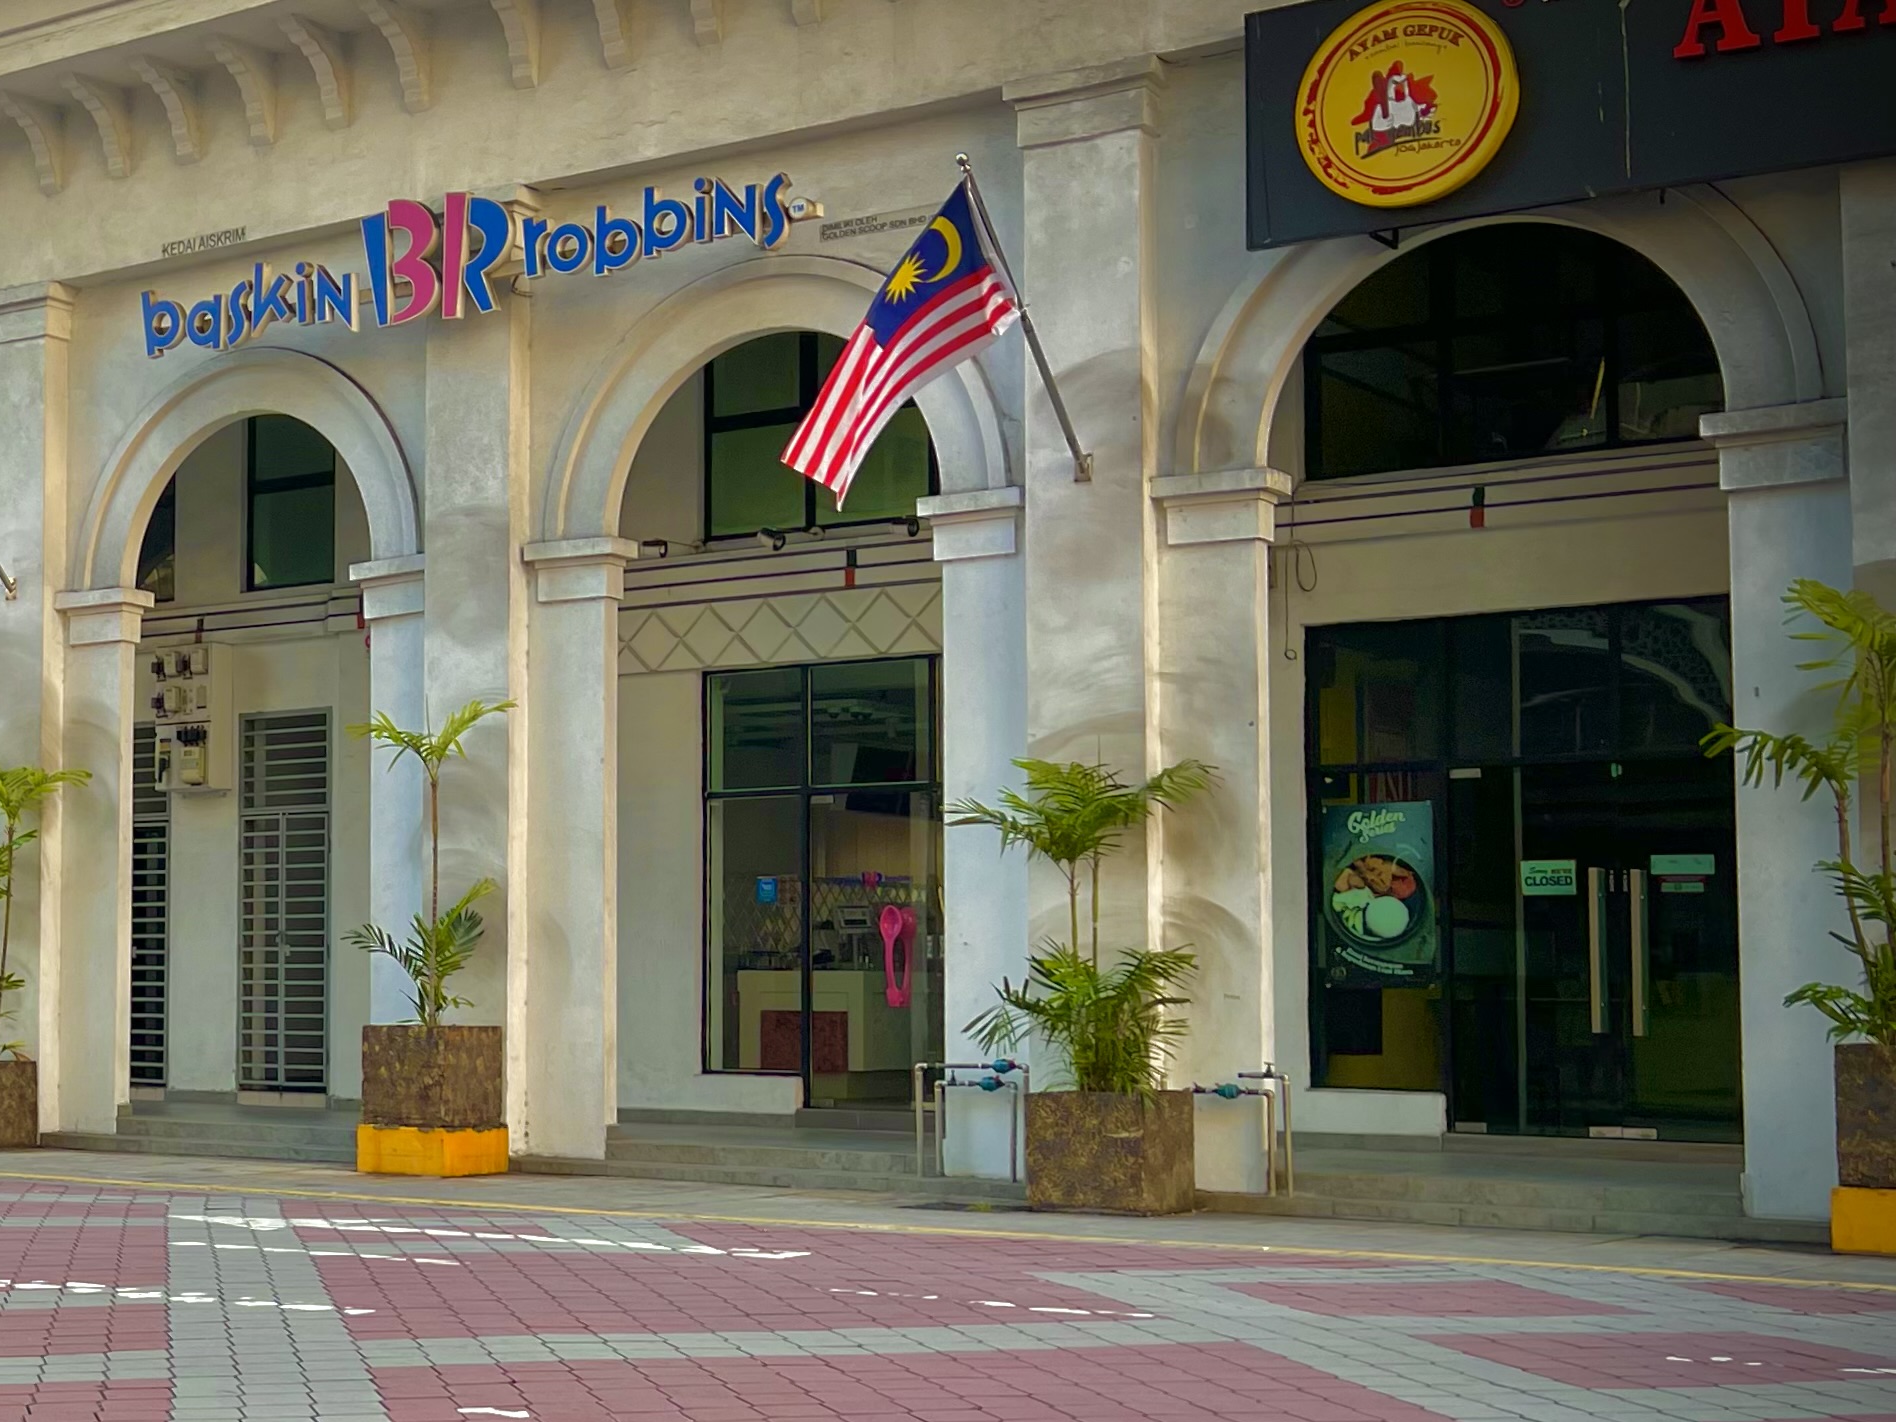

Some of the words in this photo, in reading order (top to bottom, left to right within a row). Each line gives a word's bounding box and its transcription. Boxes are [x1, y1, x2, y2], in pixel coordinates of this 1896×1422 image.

[1347, 26, 1399, 62] AYAM
[1402, 24, 1466, 47] GEPUK
[821, 228, 857, 241] GOLDEN
[858, 222, 887, 234] SCOOP
[889, 219, 907, 229] SDN
[908, 215, 927, 225] BHD
[855, 216, 878, 226] OLEH
[162, 238, 196, 257] KEDAI
[197, 226, 247, 251] AISKRIM
[140, 261, 360, 359] baskin
[360, 191, 515, 328] BR
[792, 203, 805, 214] TM
[1347, 808, 1406, 834] Golden
[1524, 875, 1573, 886] CLOSED
